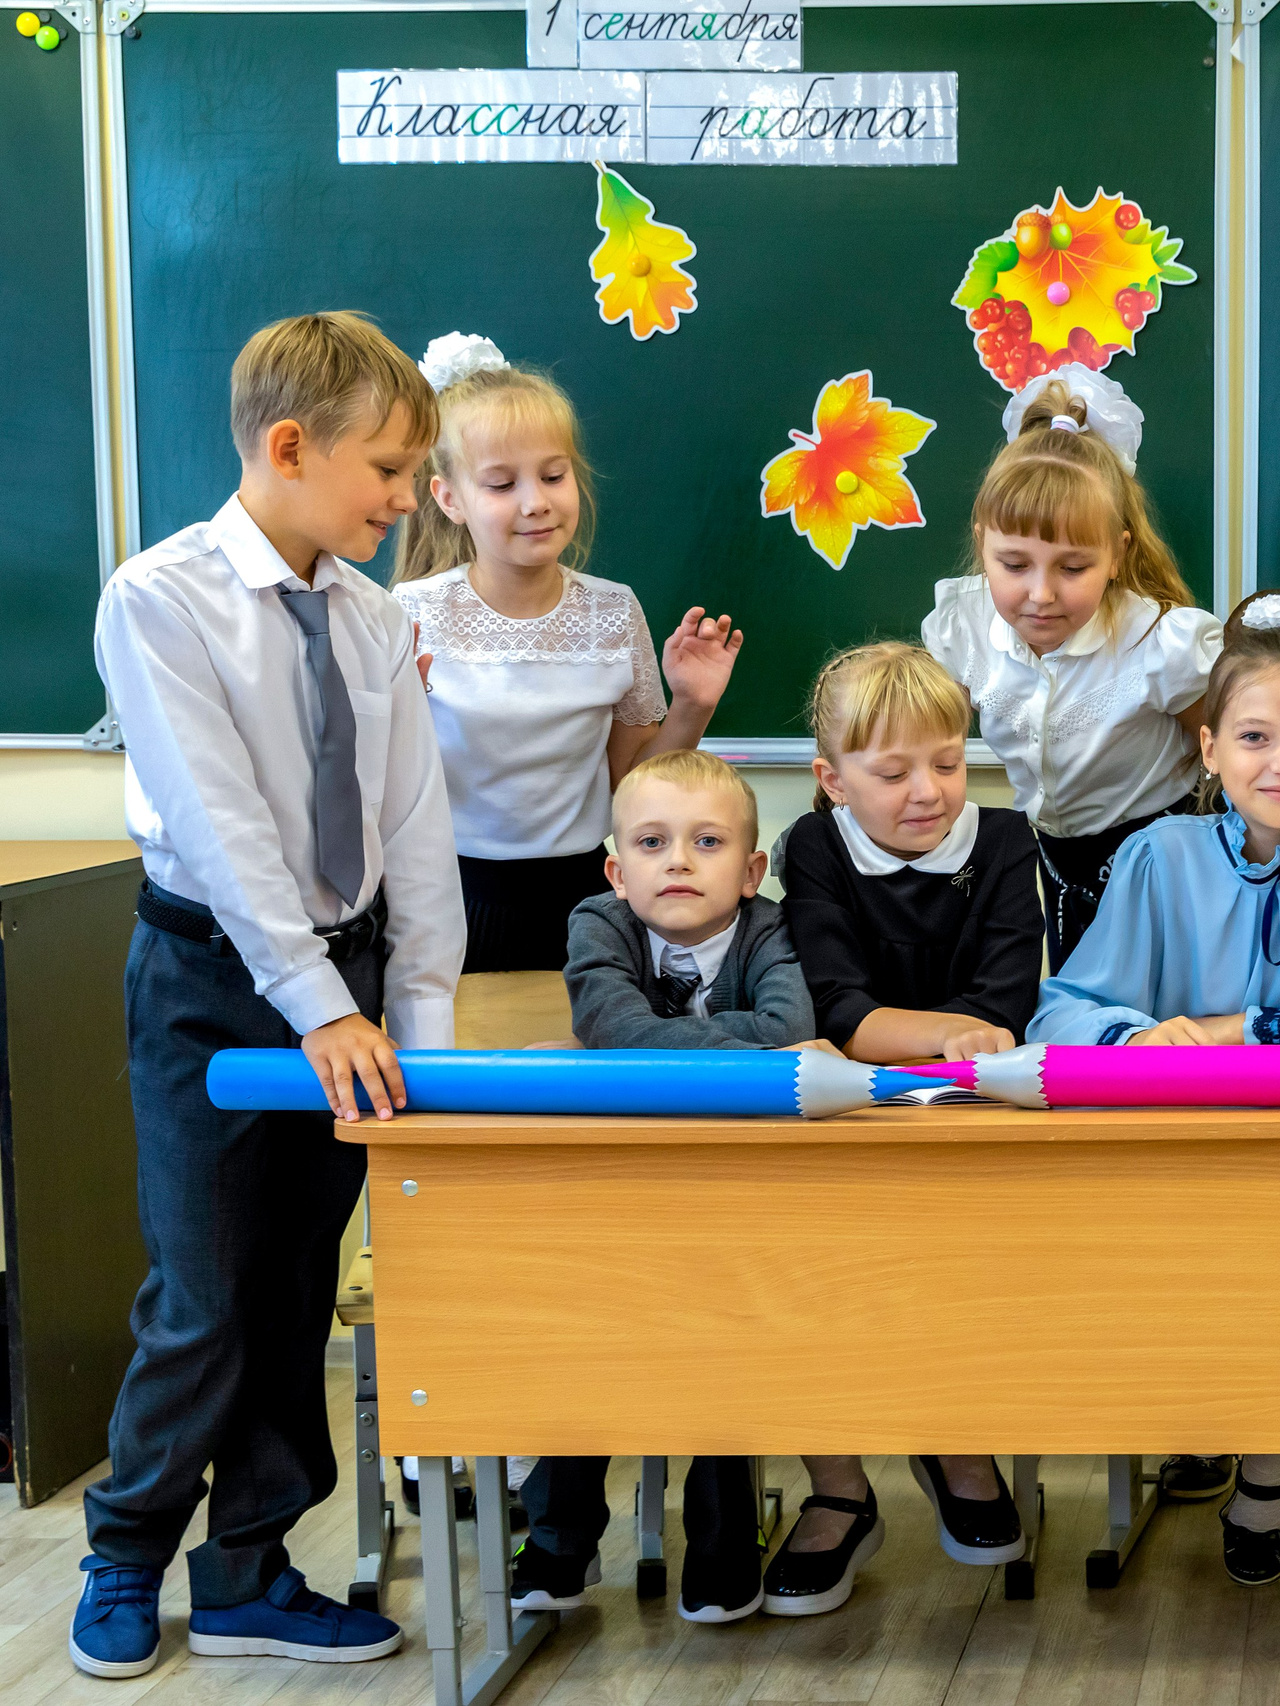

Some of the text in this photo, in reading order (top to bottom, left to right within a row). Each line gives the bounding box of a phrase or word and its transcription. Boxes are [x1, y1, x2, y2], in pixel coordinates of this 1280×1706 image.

[546, 0, 799, 63] 1 сентября
[357, 75, 927, 161] Классная работа
